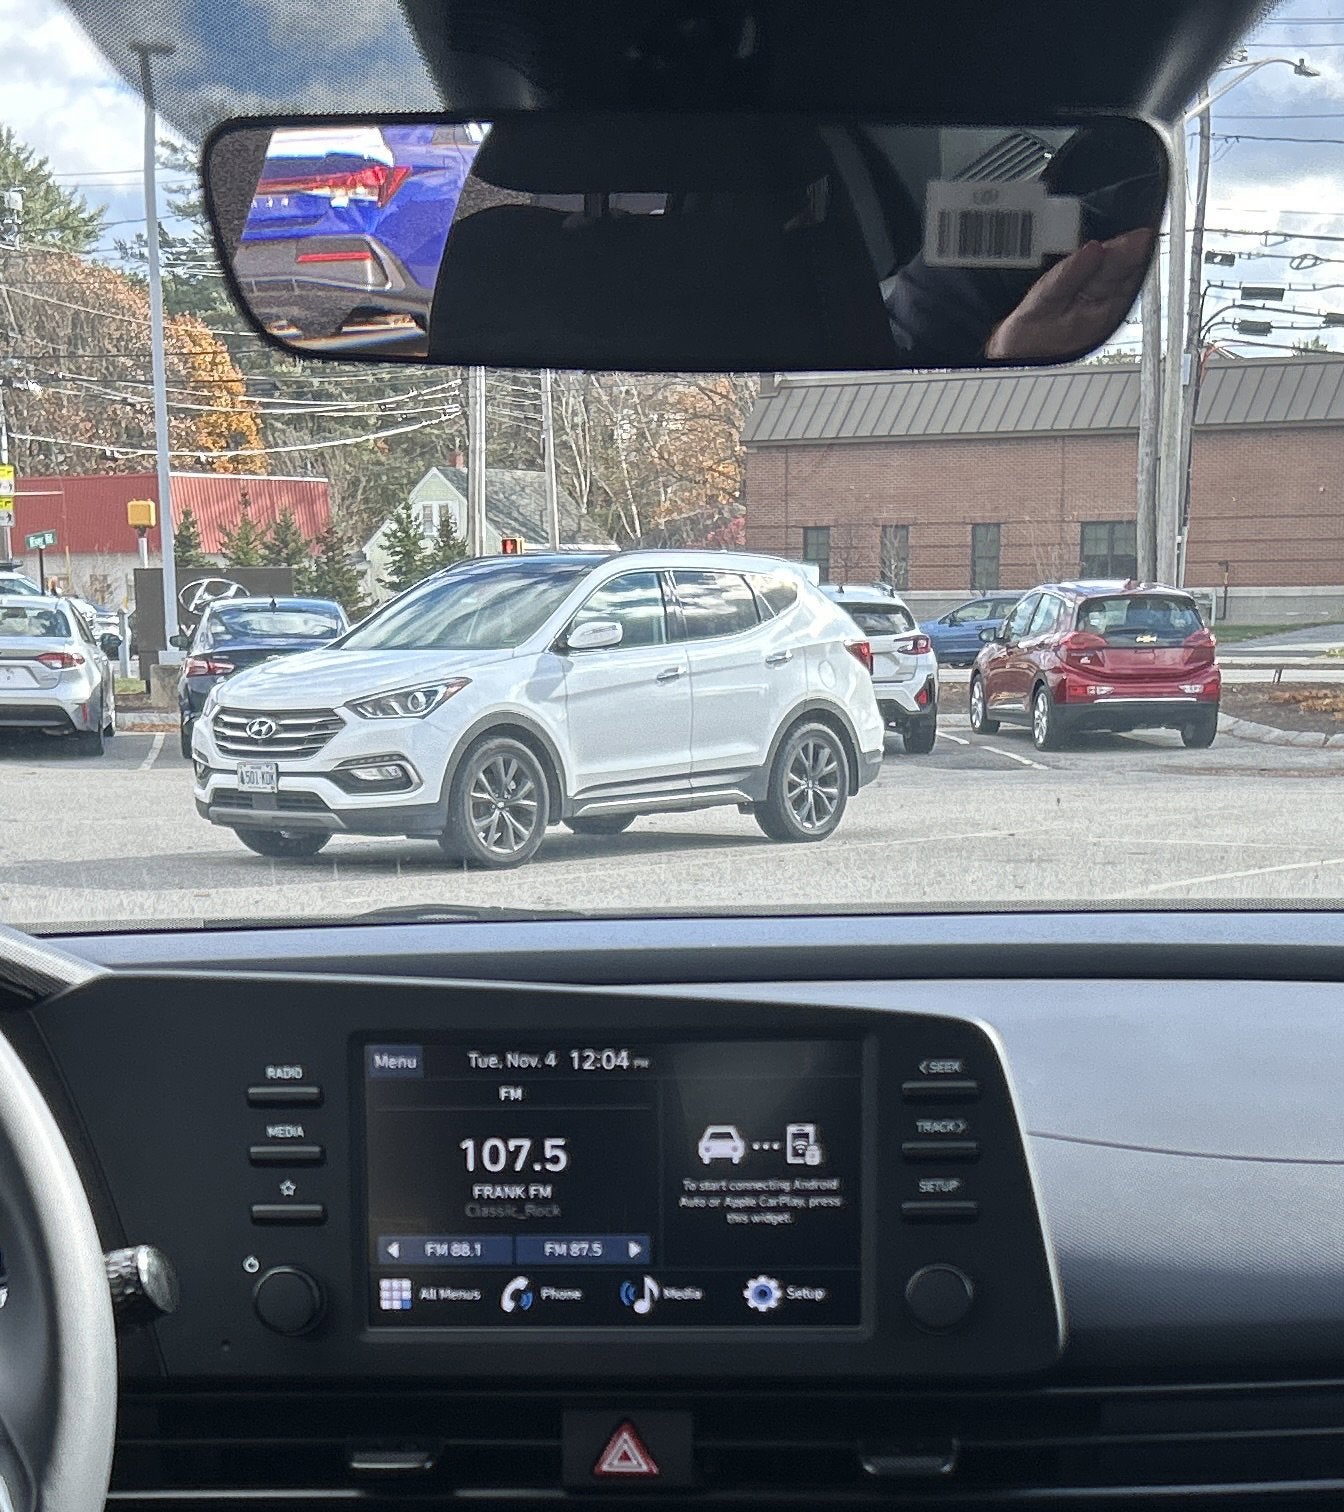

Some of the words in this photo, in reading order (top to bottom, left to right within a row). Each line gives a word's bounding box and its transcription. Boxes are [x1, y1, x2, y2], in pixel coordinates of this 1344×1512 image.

[374, 1055, 417, 1069] Menu
[506, 1051, 542, 1069] Nov.
[544, 1051, 557, 1068] 4
[569, 1049, 630, 1070] 12:04
[265, 1065, 303, 1079] RADIO
[499, 1086, 523, 1101] FM
[266, 1124, 305, 1138] MEDIA
[459, 1137, 568, 1173] 107.5
[472, 1185, 526, 1199] FRANK
[529, 1184, 553, 1199] FM
[682, 1178, 697, 1191] To
[699, 1179, 727, 1191] start
[729, 1179, 791, 1192] connecting
[793, 1177, 840, 1190] Android
[919, 1179, 961, 1193] SETUP
[679, 1196, 706, 1208] Auto
[708, 1198, 721, 1208] or
[723, 1196, 757, 1209] Apple
[809, 1197, 842, 1209] press
[464, 1204, 562, 1219] Classic_Rock
[726, 1212, 749, 1224] this
[751, 1212, 792, 1226] widget.
[424, 1242, 448, 1257] FM
[543, 1242, 567, 1257] FM
[569, 1242, 603, 1257] 87.5
[419, 1287, 438, 1301] All
[440, 1287, 482, 1301] Menus
[540, 1287, 583, 1301] Phone
[662, 1287, 703, 1300] Media
[787, 1286, 826, 1302] Setup
